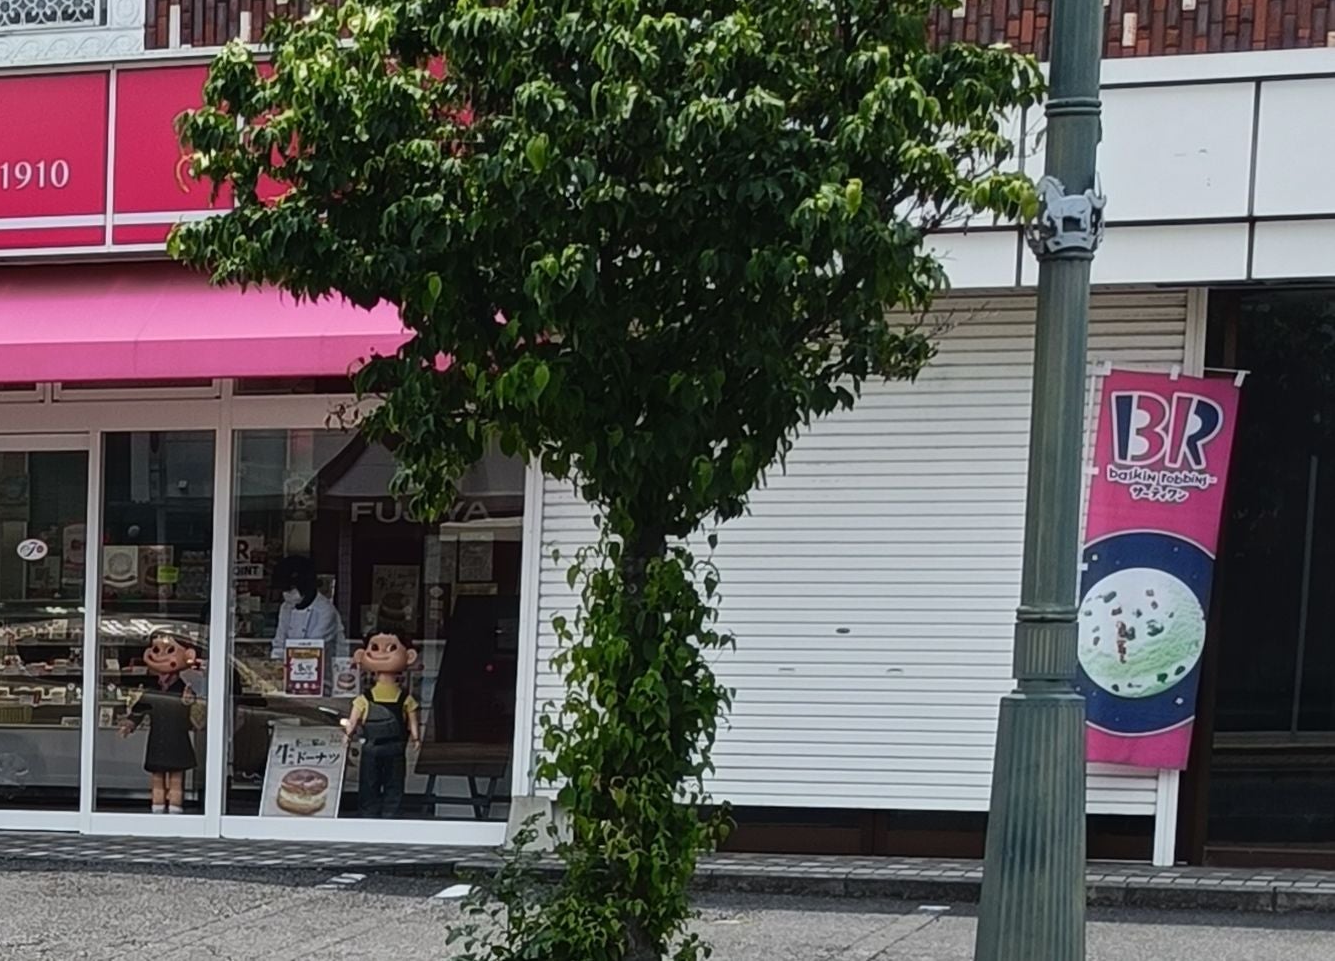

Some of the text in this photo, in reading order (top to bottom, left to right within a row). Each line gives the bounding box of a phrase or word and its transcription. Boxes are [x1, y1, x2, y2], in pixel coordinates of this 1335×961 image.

[0, 159, 69, 190] 1910
[1111, 391, 1224, 470] BR
[1130, 484, 1189, 502] サーティワン
[351, 500, 489, 523] FUYA
